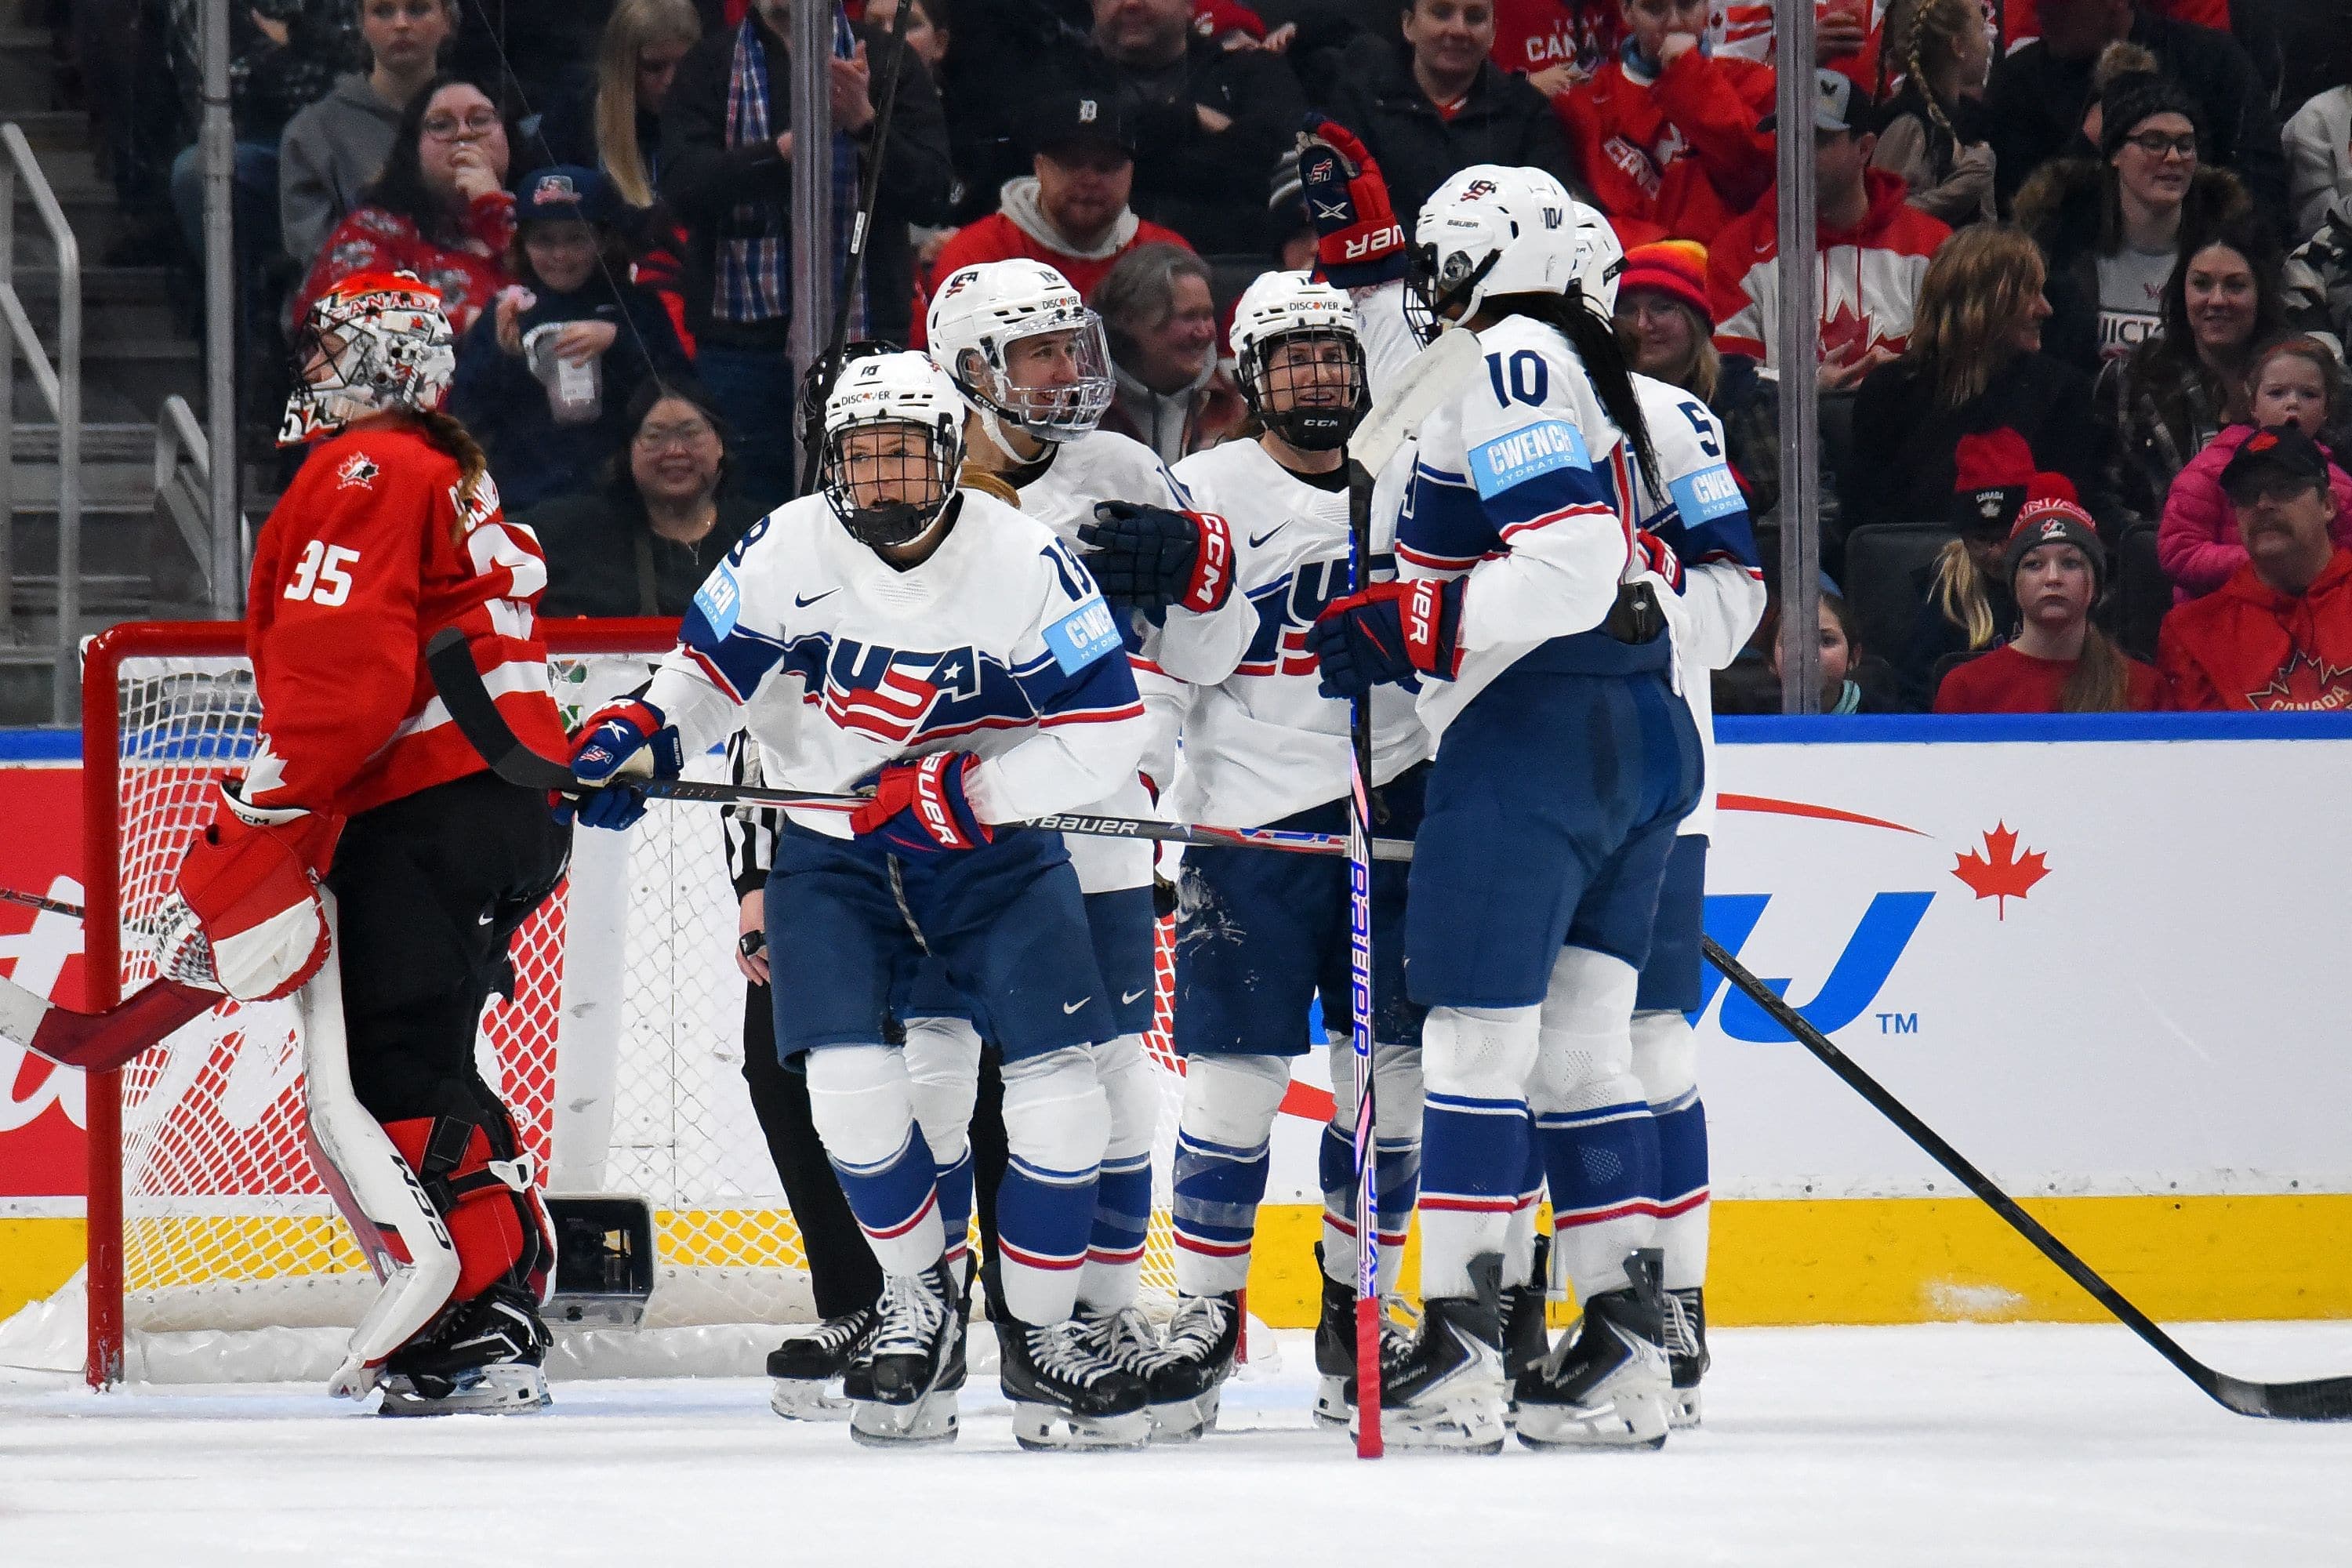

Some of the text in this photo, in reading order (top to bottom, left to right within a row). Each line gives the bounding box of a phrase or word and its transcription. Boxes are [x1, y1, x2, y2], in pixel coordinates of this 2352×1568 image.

[1041, 296, 1080, 310] DISCOVER
[1289, 301, 1339, 311] DISCOVER
[841, 391, 891, 406] DISCOVER
[1484, 350, 1548, 409] 10
[1487, 424, 1574, 476] CWENCH
[1676, 401, 1721, 457] 5
[283, 539, 361, 608] 35
[1196, 514, 1225, 604] CCM
[826, 636, 982, 746] USA
[1039, 815, 1140, 836] BAUER
[1875, 1012, 1918, 1035] TM
